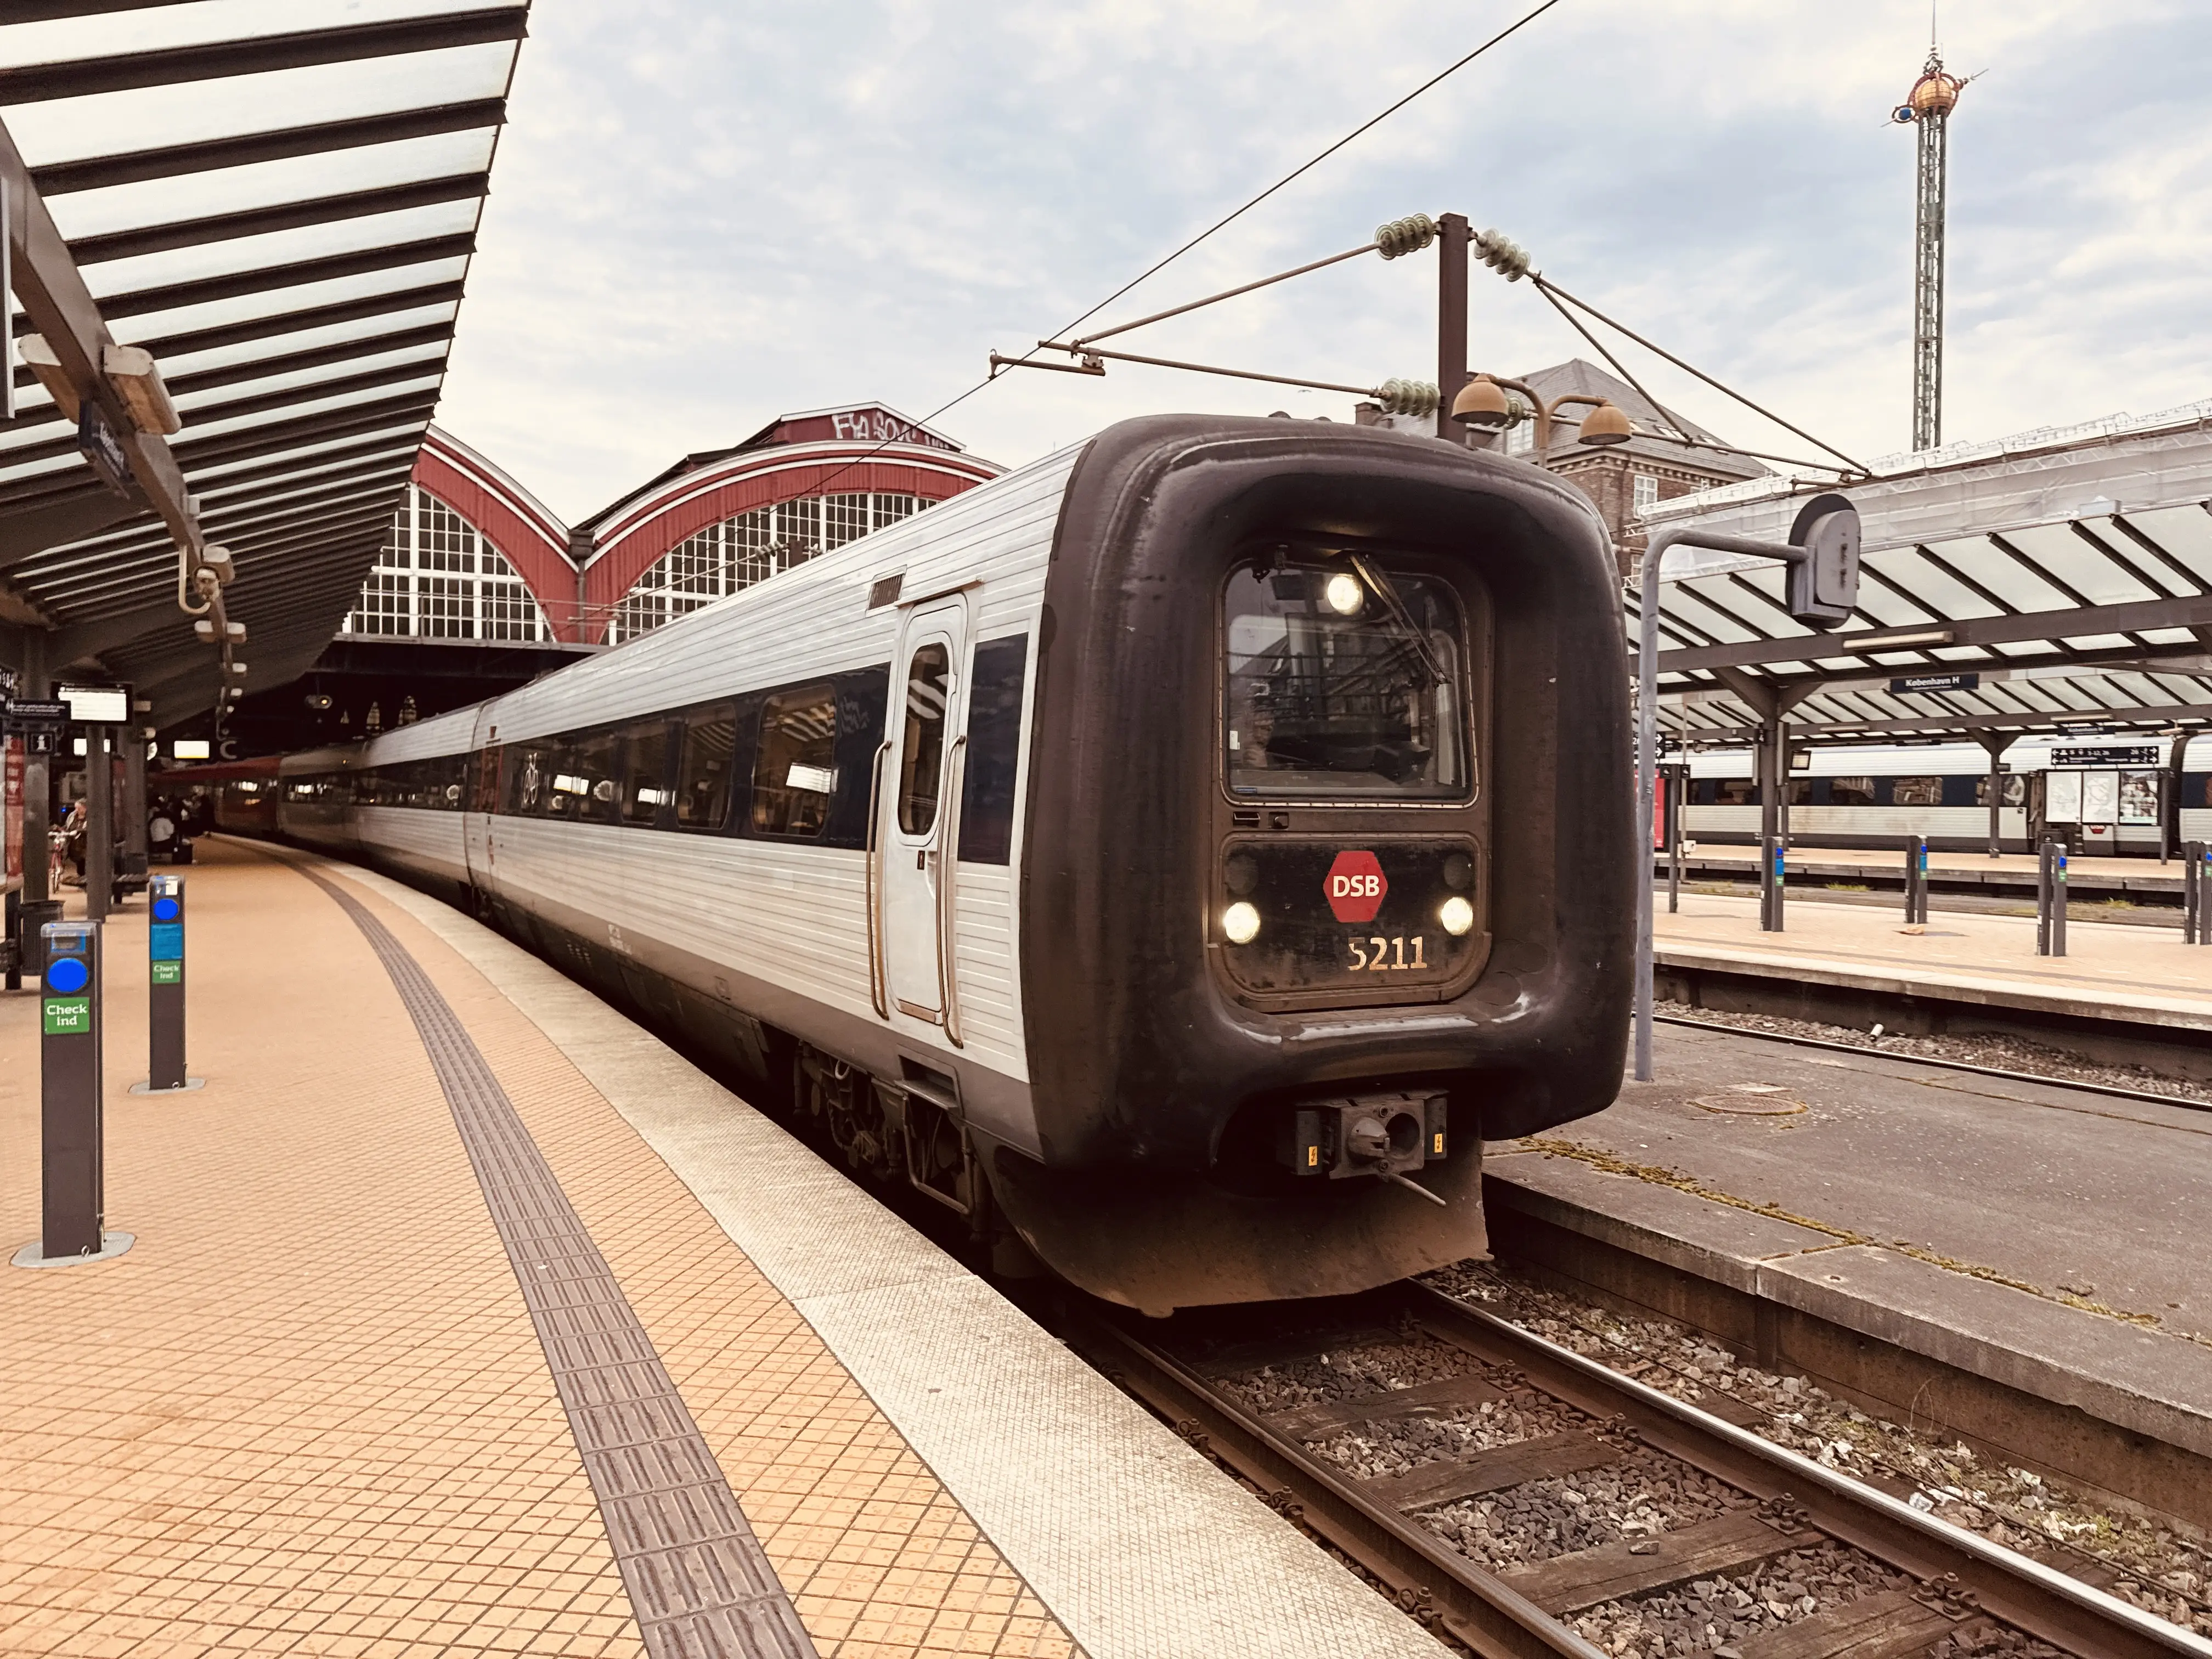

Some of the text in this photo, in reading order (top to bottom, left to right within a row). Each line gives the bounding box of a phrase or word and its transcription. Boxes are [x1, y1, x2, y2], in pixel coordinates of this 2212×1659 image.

[1333, 874, 1380, 898] DSB
[1347, 936, 1427, 970] 5211
[153, 964, 179, 973] Check
[47, 1003, 87, 1015] Check
[57, 1015, 78, 1026] Ind
